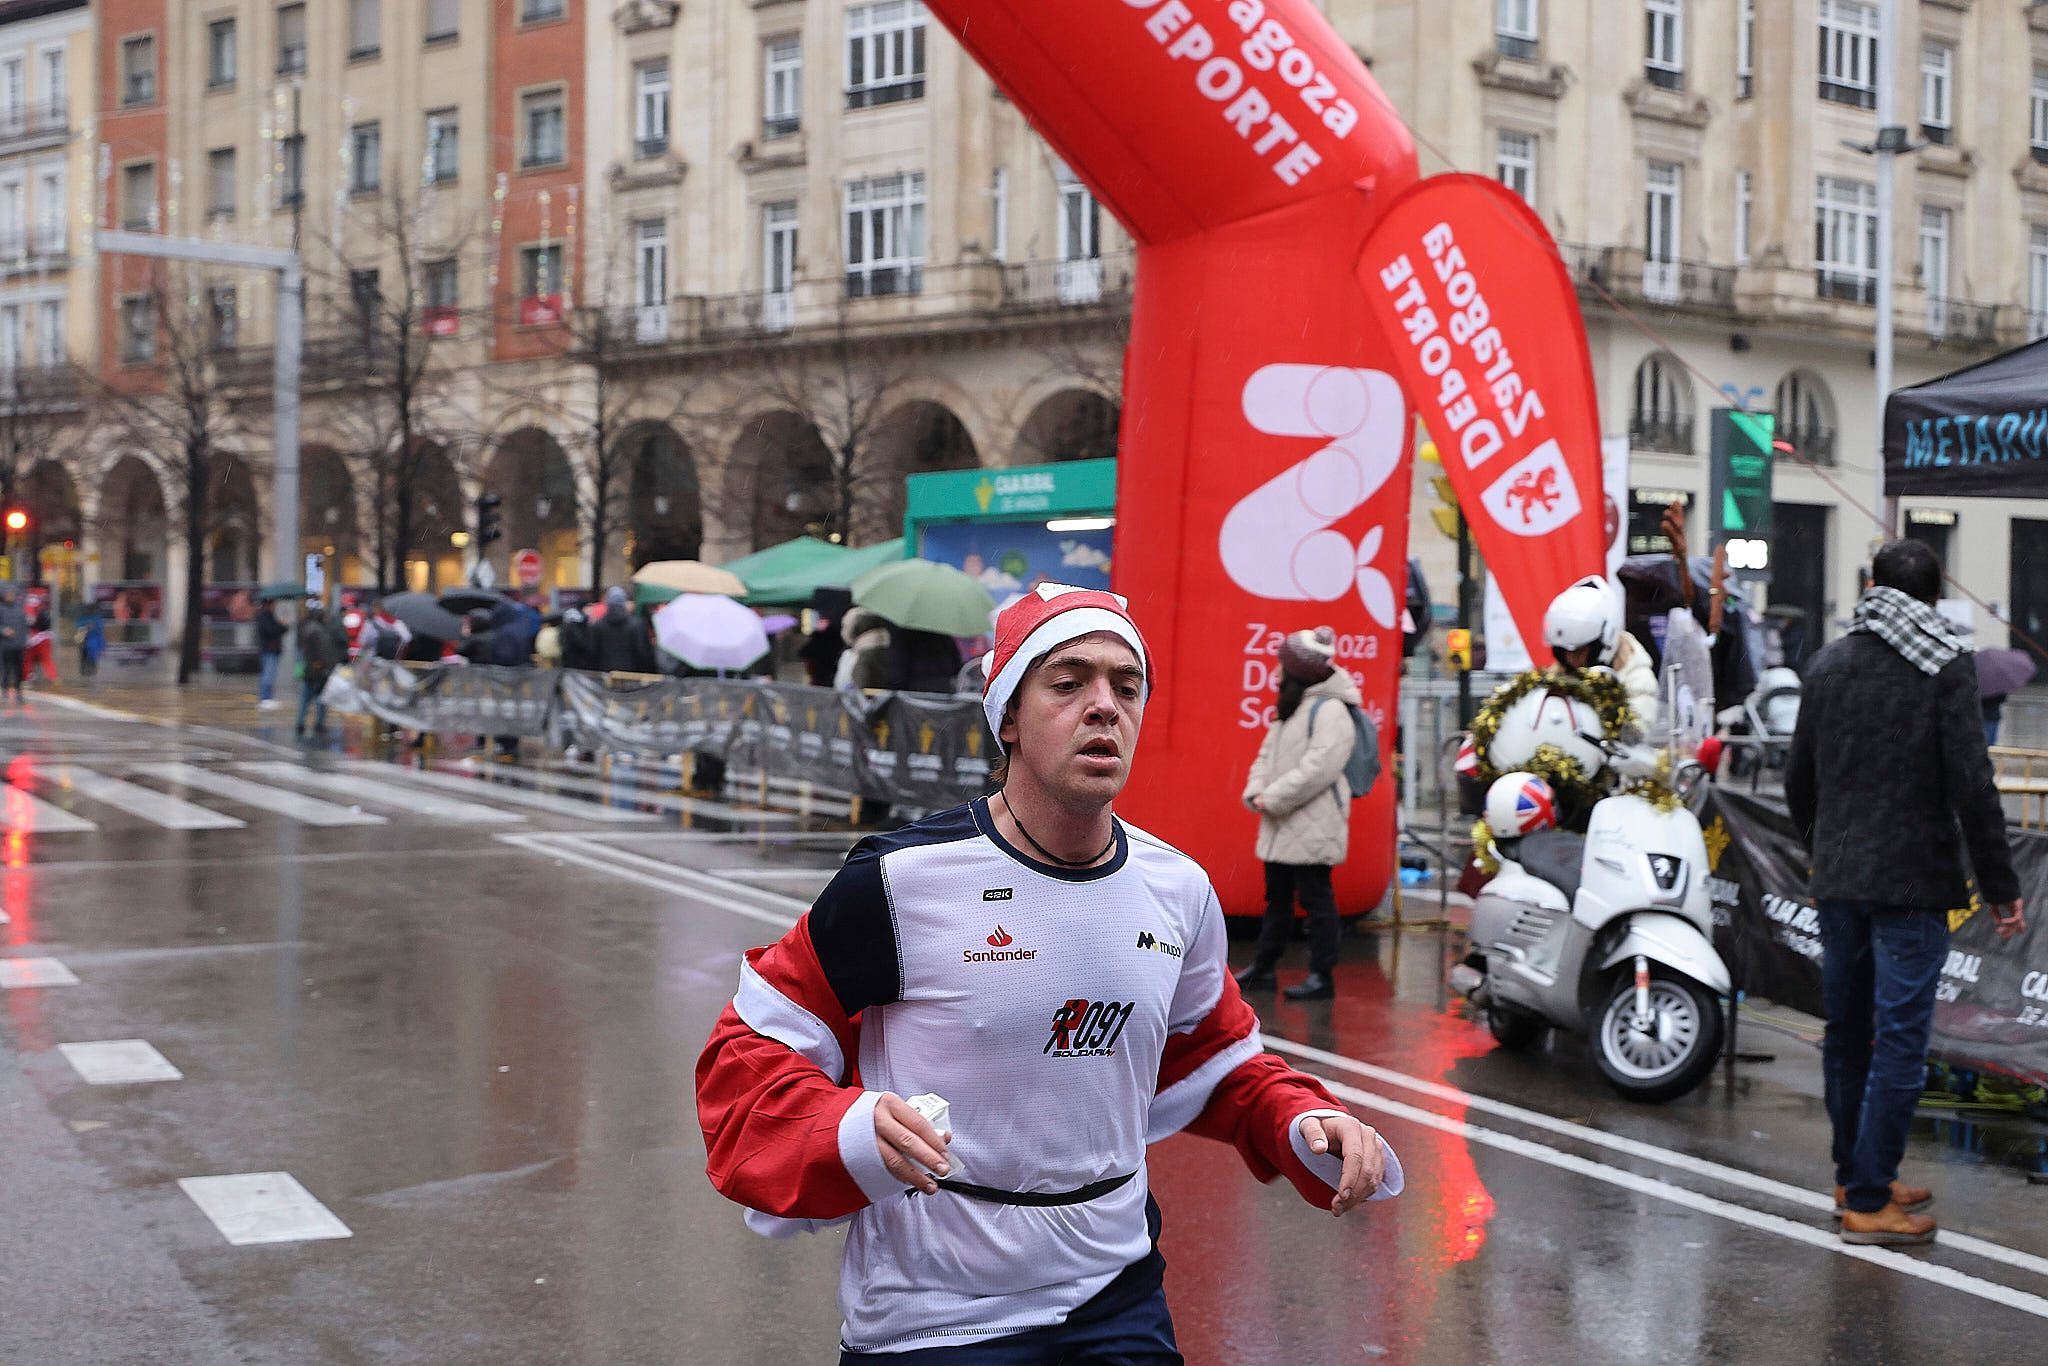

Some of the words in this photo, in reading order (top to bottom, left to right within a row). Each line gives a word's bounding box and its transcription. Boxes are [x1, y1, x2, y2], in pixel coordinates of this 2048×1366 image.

[1121, 0, 1322, 186] EPORTE
[1216, 0, 1358, 139] agoza
[1904, 408, 2048, 468] METARU
[1243, 623, 1378, 659] Zaoza
[963, 949, 1037, 962] Santander
